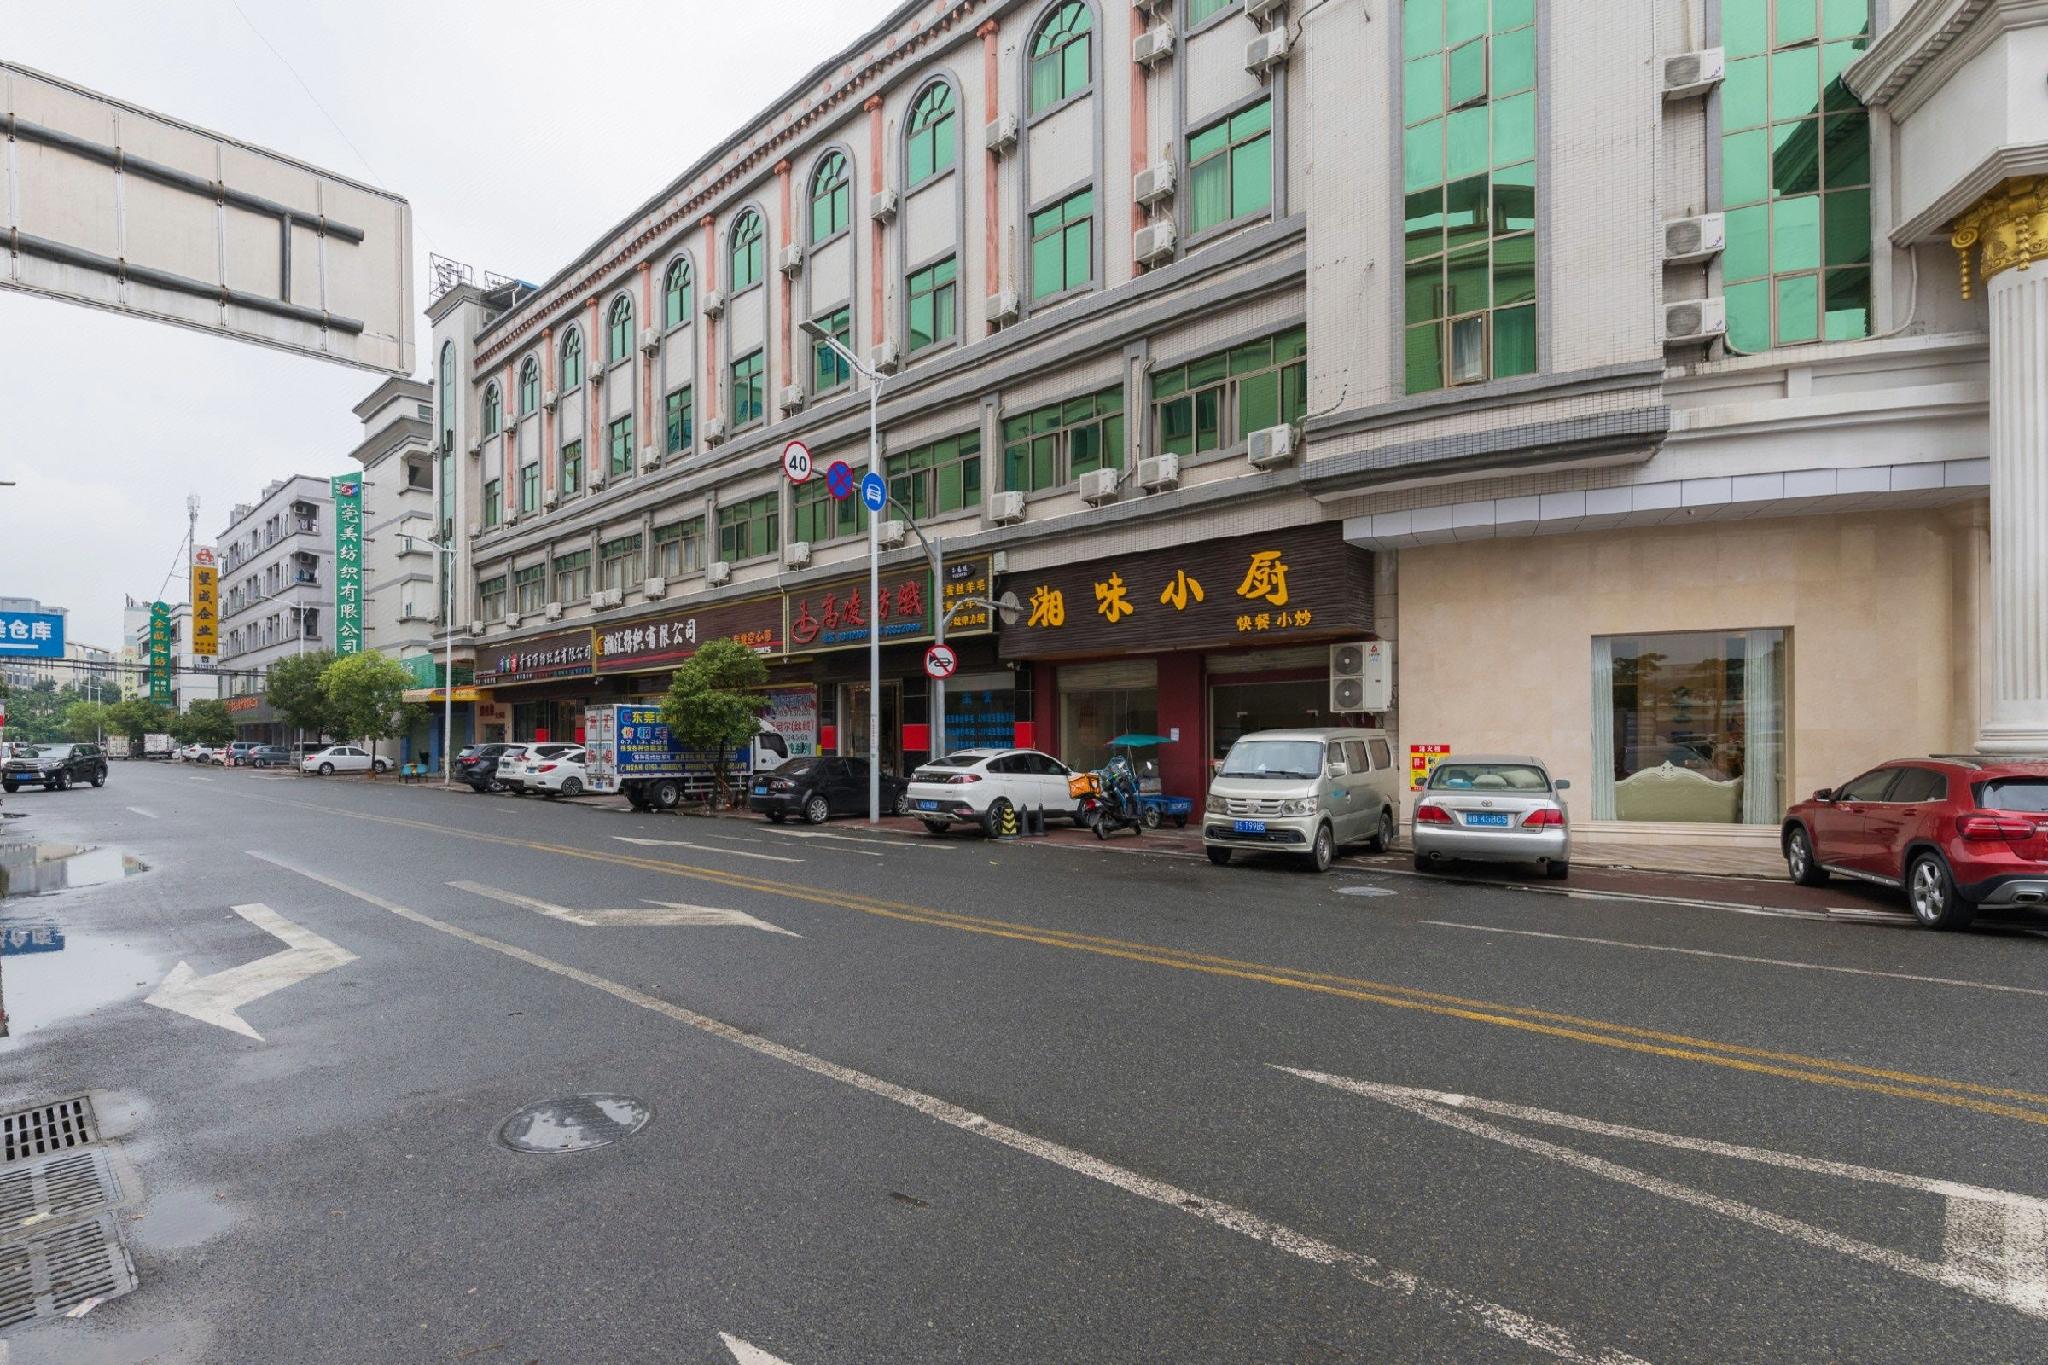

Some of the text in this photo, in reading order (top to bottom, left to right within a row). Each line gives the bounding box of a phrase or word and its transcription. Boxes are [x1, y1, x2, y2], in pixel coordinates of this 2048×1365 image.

[789, 455, 807, 472] 40
[1027, 551, 1289, 627] 湘味小厨
[1236, 609, 1312, 632] 快餐 小炒
